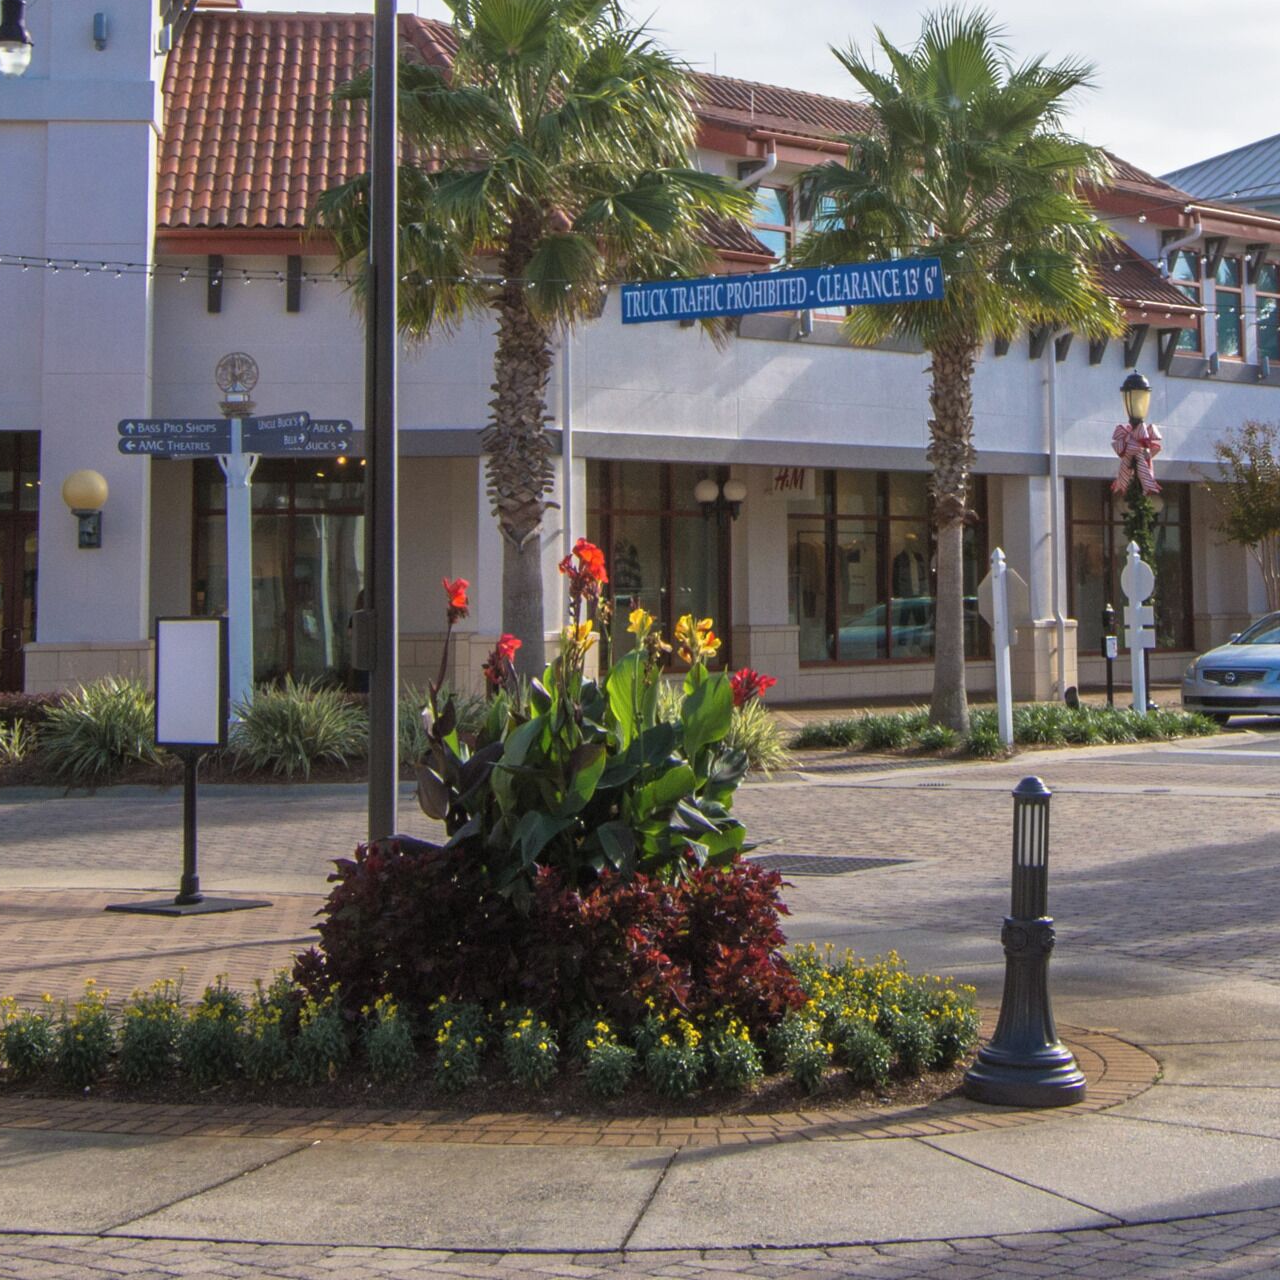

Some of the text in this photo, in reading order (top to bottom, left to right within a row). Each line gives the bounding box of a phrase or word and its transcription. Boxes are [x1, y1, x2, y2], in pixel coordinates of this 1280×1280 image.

[624, 288, 669, 318] TRUCK
[671, 283, 724, 314] TRAFFIC
[726, 276, 807, 310] PROHIBITED
[816, 268, 902, 303] CLEARANCE
[138, 422, 217, 433] BASS PRO SHOPS
[138, 440, 211, 451] AMC THEATRES
